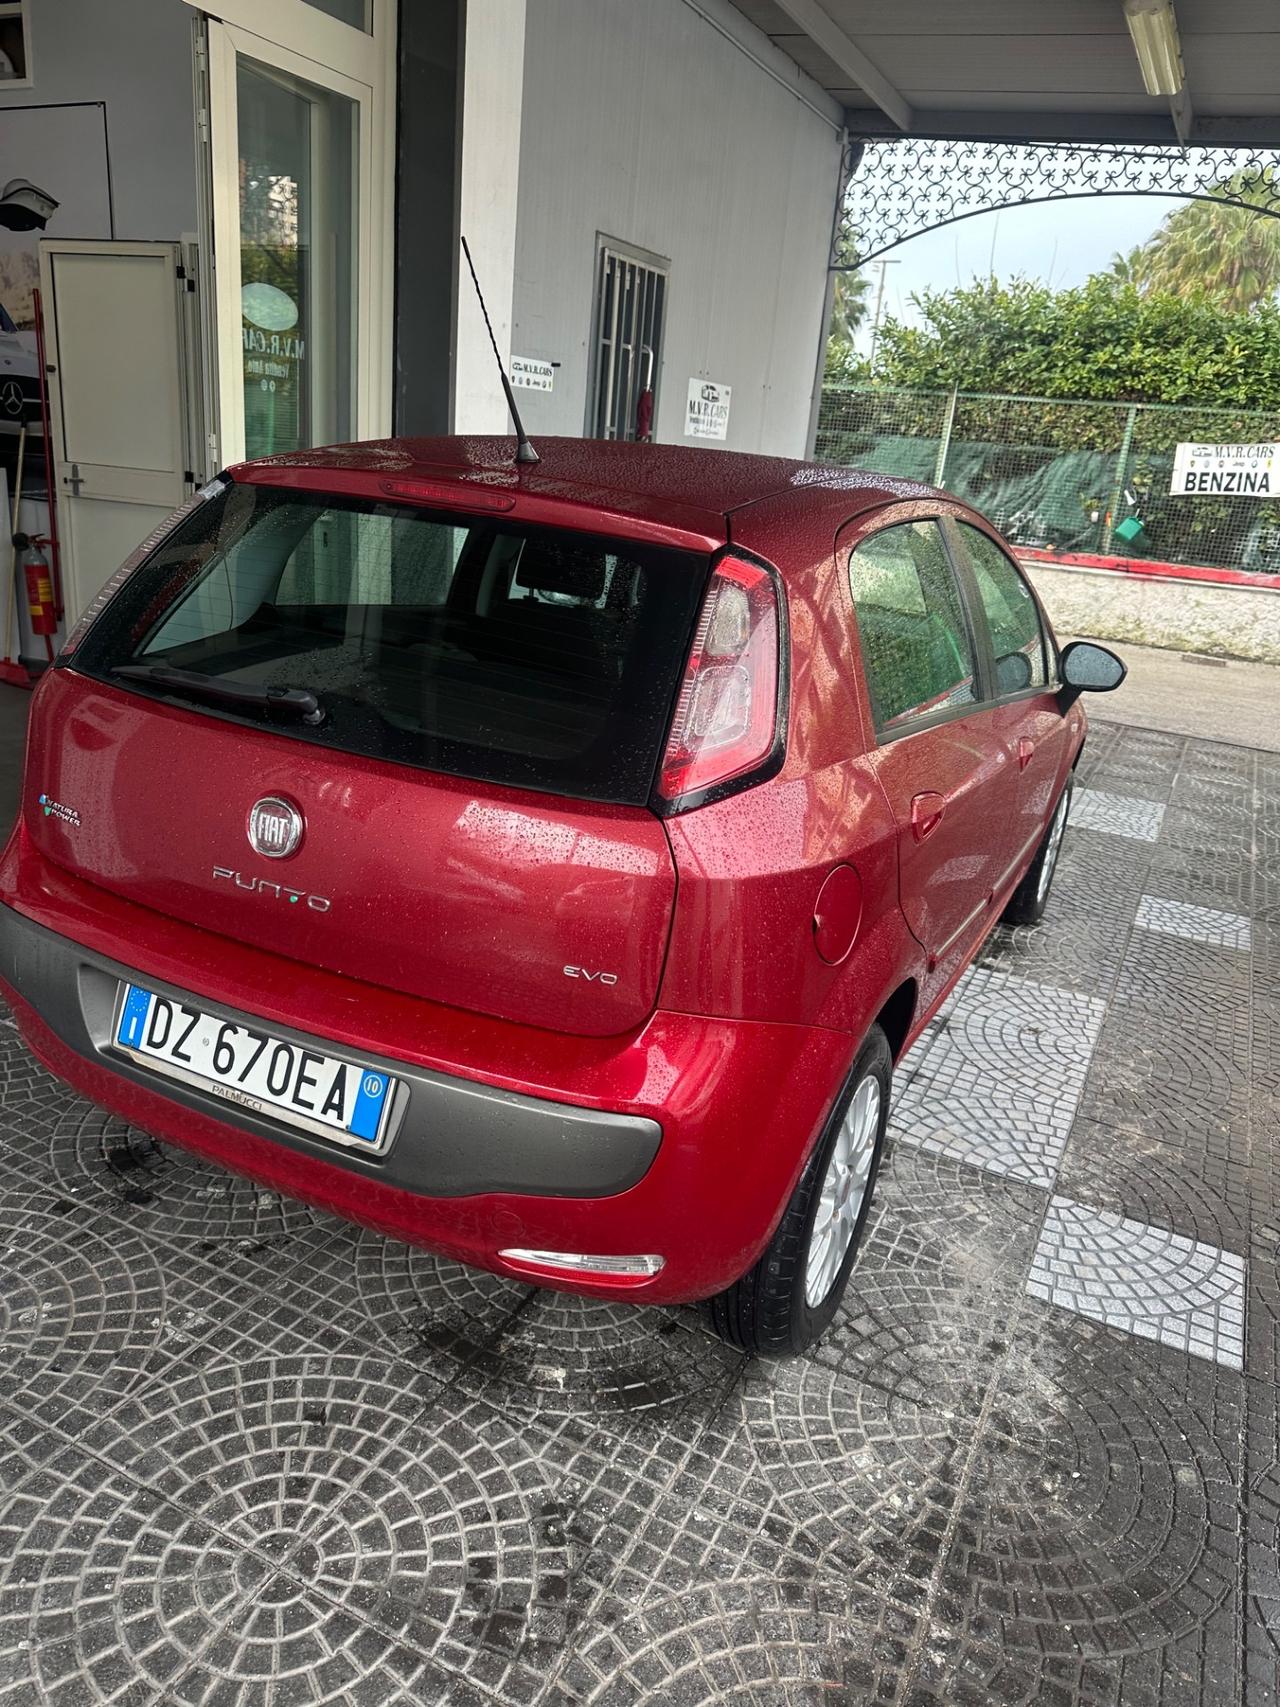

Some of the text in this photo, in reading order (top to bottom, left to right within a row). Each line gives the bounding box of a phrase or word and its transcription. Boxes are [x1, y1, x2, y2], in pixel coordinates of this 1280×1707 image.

[1184, 471, 1270, 493] BENZINA
[51, 809, 81, 827] POWER
[257, 813, 288, 845] FIAT
[212, 864, 331, 913] PUNTO
[563, 965, 618, 985] EVO
[146, 997, 201, 1063] DZ
[211, 1084, 263, 1111] PALMUCCI
[366, 1078, 379, 1094] 10
